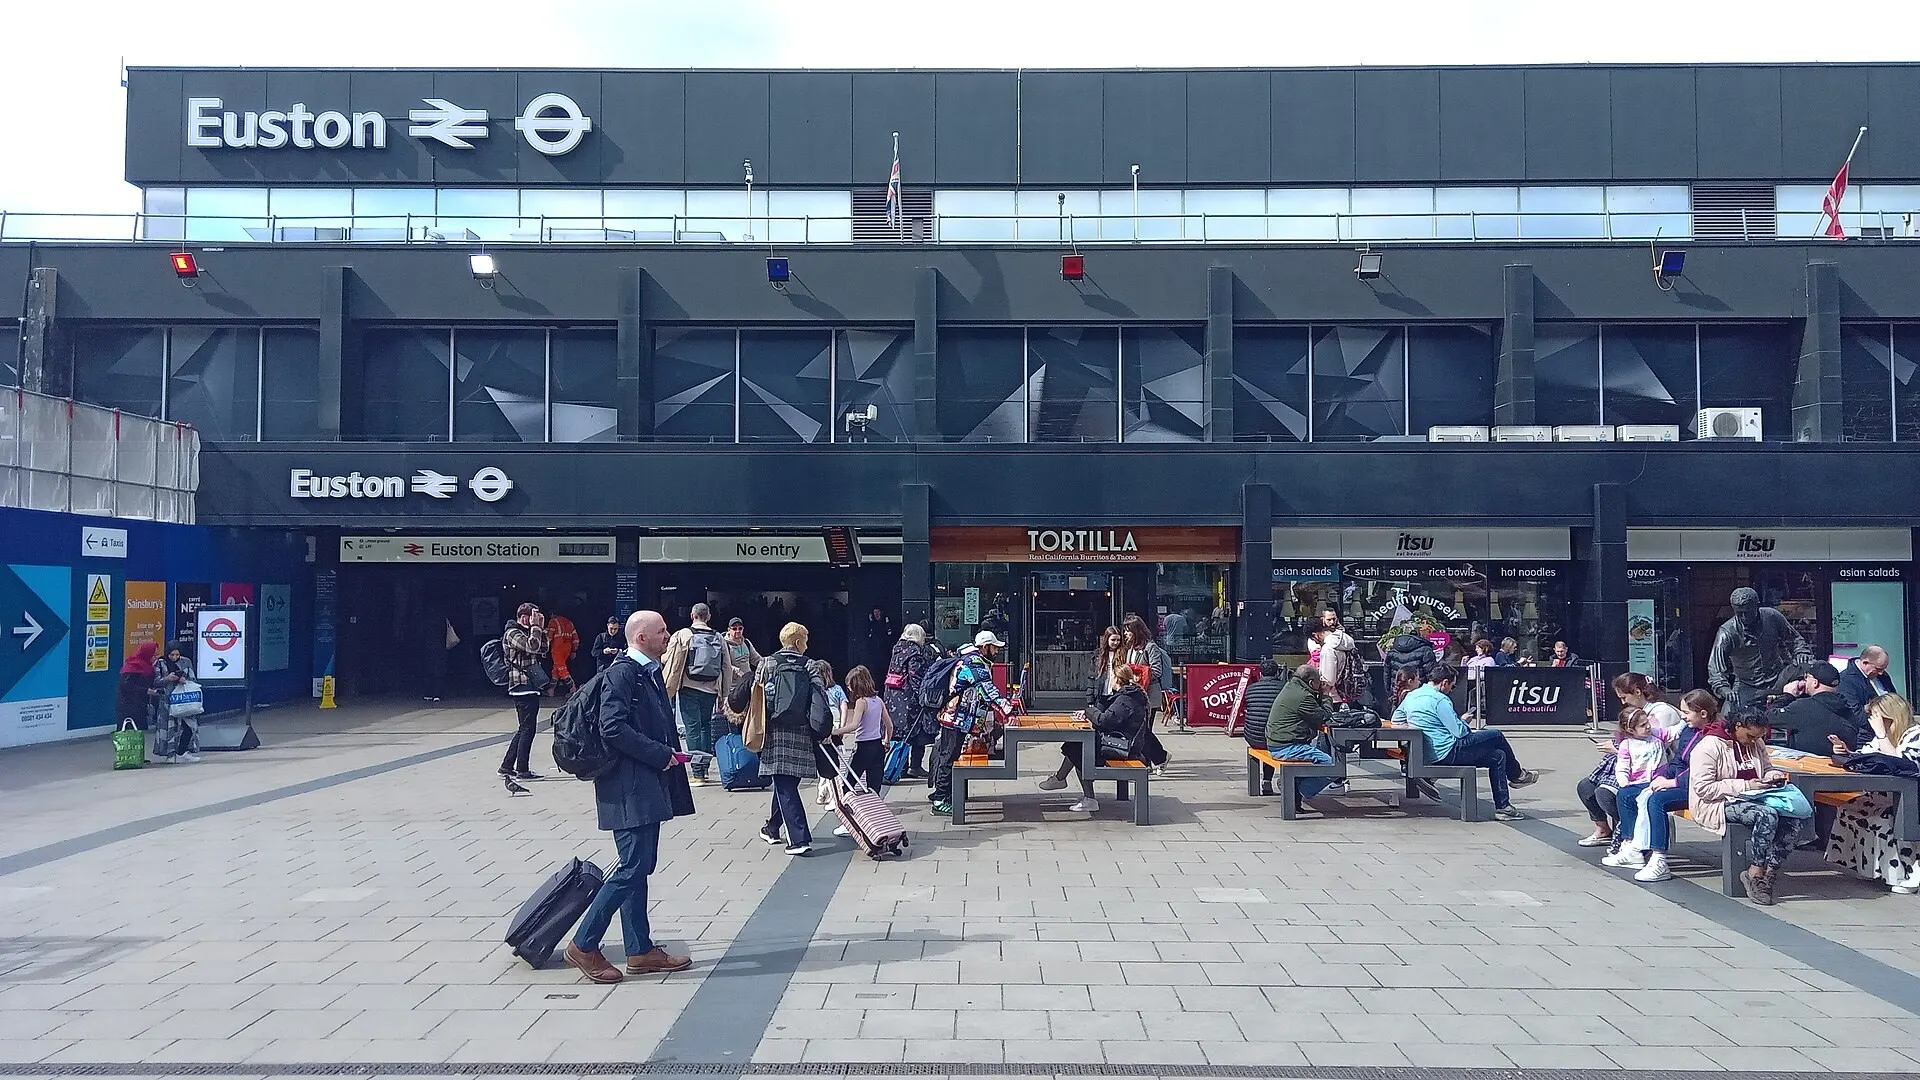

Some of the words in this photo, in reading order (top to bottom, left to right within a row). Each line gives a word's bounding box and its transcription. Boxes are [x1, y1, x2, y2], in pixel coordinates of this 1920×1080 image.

[187, 97, 388, 149] Euston
[290, 469, 405, 498] Euston
[110, 538, 124, 547] Taxis
[1027, 530, 1138, 551] TORTILLA
[1397, 532, 1435, 550] itsu
[1737, 533, 1776, 551] itsu
[431, 543, 483, 556] Euston
[486, 543, 540, 556] Station
[736, 543, 757, 556] No
[760, 544, 801, 559] entry
[1045, 553, 1080, 561] California
[1273, 567, 1299, 576] asian
[1301, 566, 1332, 576] salads
[1354, 567, 1380, 577] sushi
[1389, 568, 1418, 579] soups
[1428, 567, 1446, 577] rice
[1447, 567, 1476, 577] bowls
[1501, 567, 1516, 577] hot
[1518, 567, 1557, 577] noodles
[1626, 568, 1656, 579] gyoza
[1840, 567, 1866, 577] asian
[1868, 567, 1900, 577] salads
[127, 598, 163, 611] Sainsbury's
[1370, 594, 1409, 621] health
[1411, 594, 1461, 621] yourself
[1203, 678, 1218, 692] REAL
[1201, 687, 1240, 709] TORTI
[1508, 679, 1561, 705] itsu
